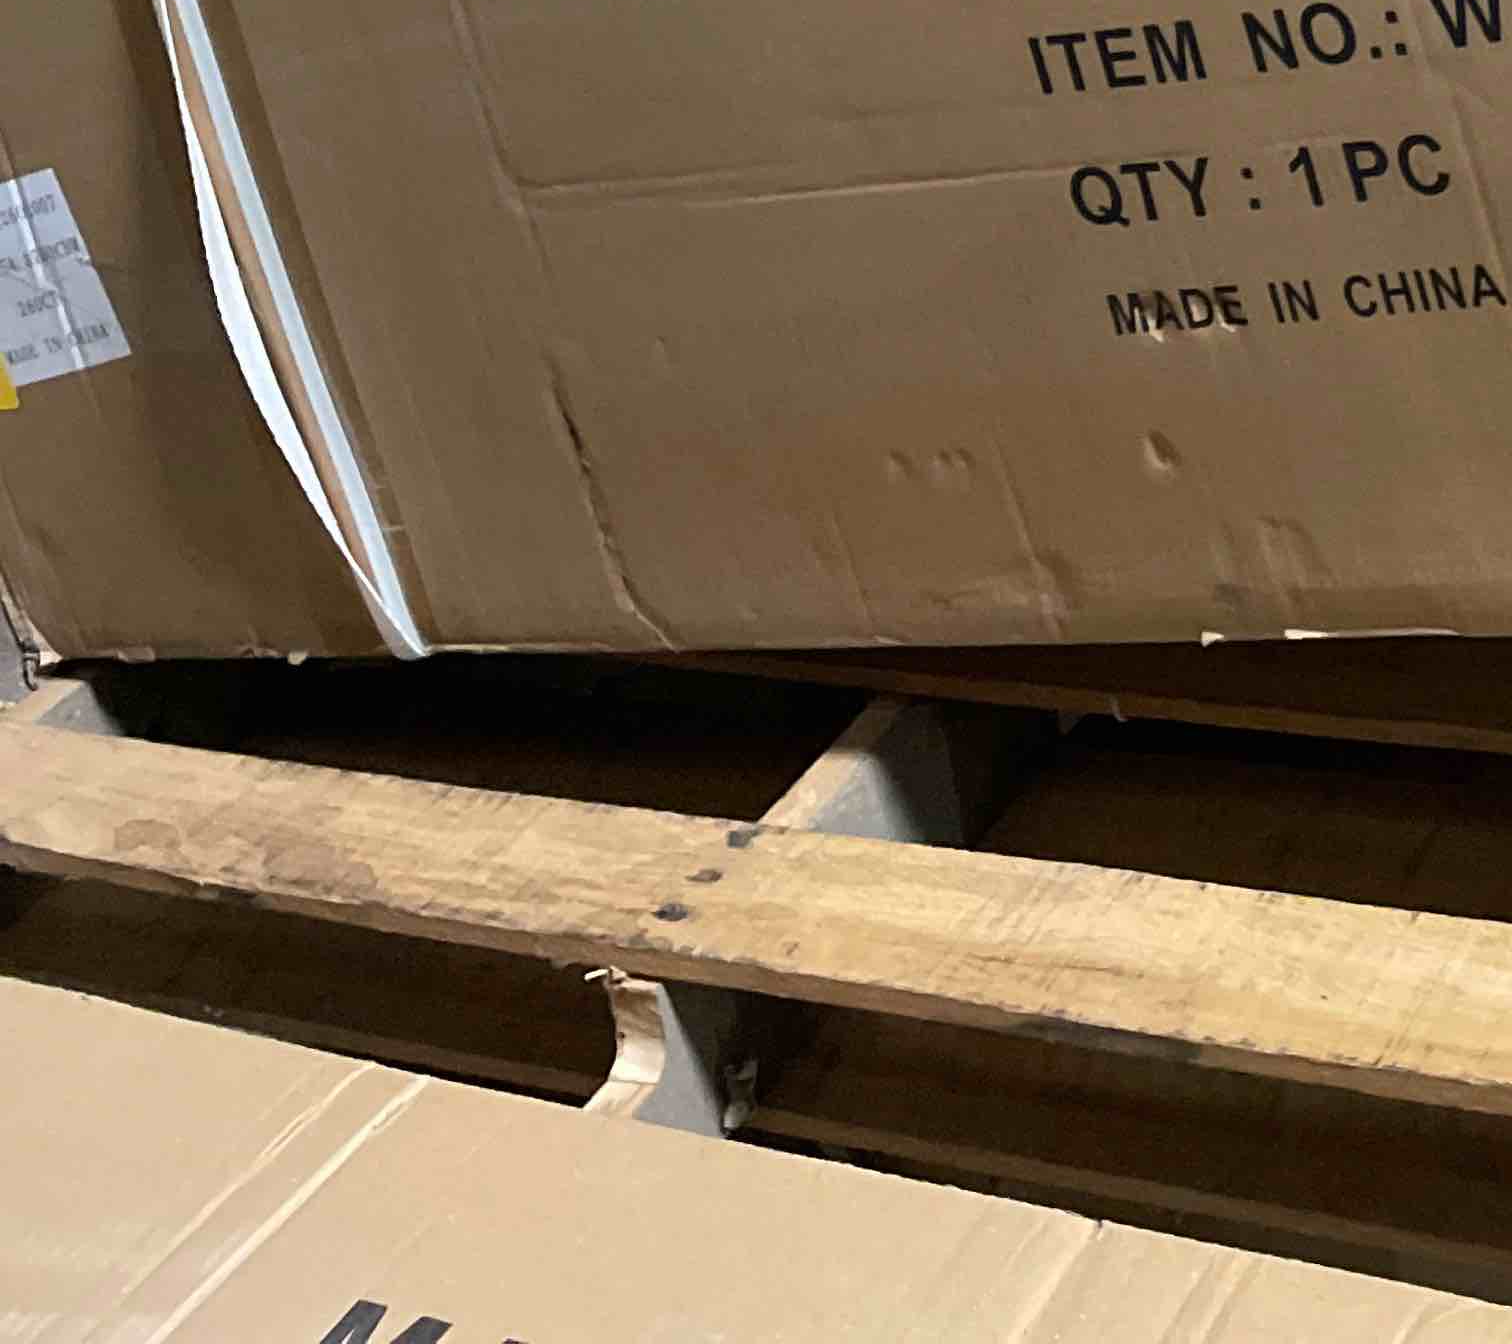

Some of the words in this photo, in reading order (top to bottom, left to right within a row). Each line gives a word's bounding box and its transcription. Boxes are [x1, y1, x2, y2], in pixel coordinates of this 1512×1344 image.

[1028, 19, 1208, 95] ITEM
[1070, 156, 1210, 227] QTY
[1106, 284, 1249, 336] MADE
[1267, 278, 1320, 324] IN
[1342, 263, 1507, 318] CHINA
